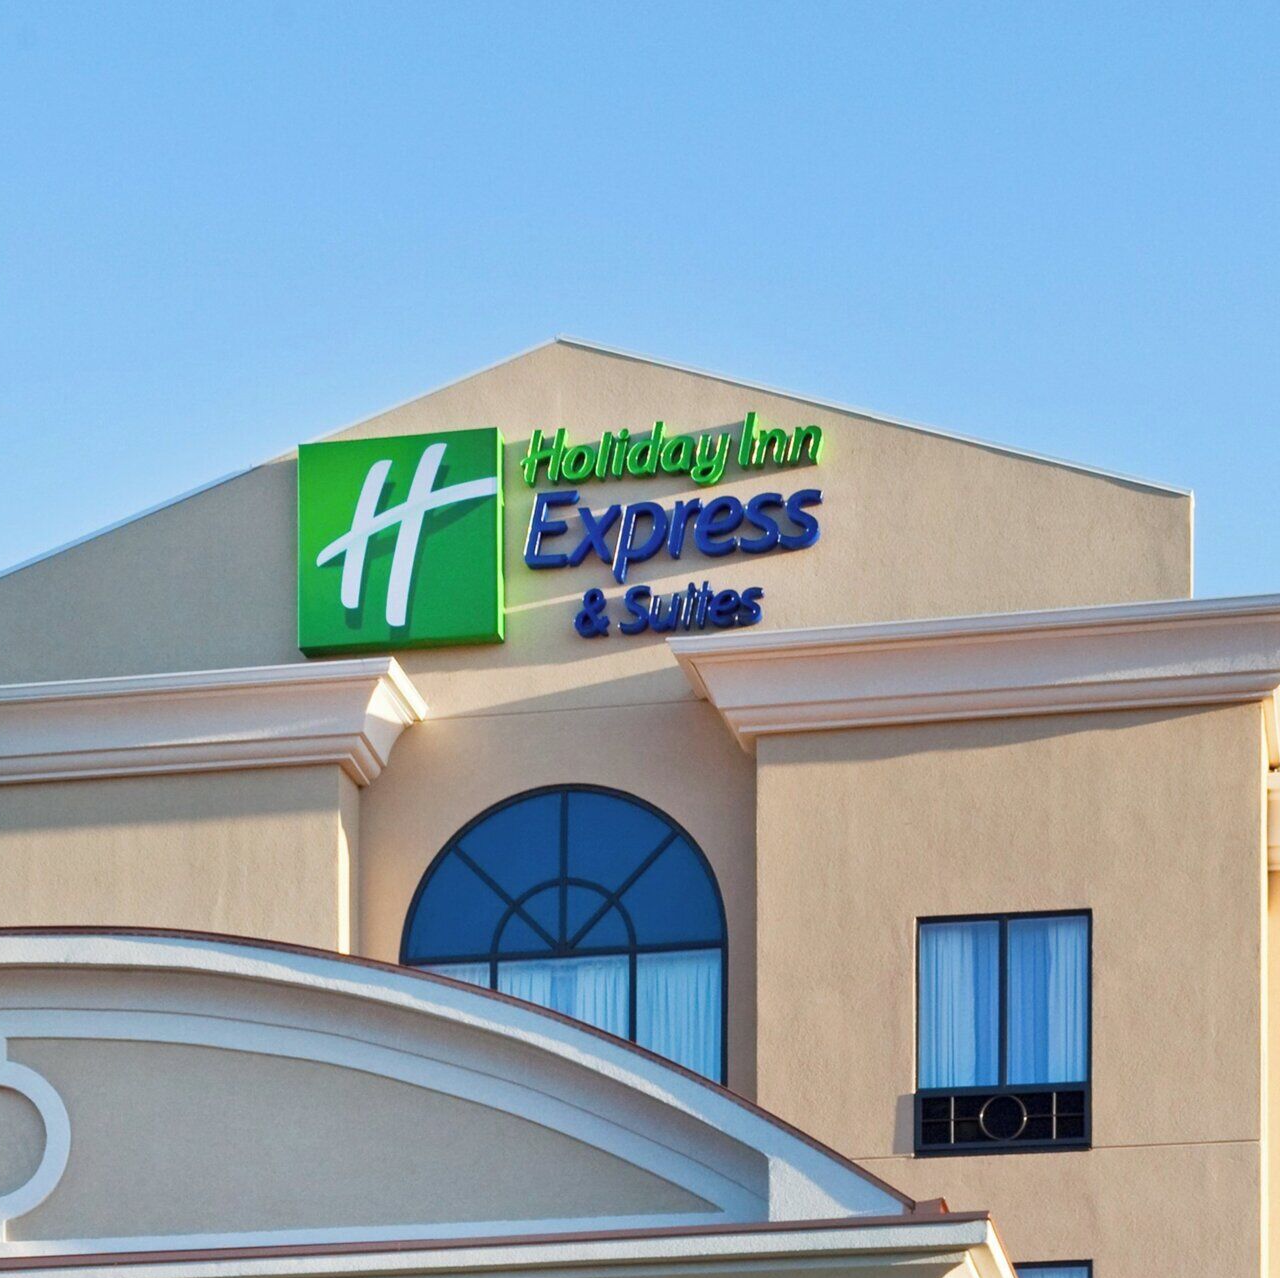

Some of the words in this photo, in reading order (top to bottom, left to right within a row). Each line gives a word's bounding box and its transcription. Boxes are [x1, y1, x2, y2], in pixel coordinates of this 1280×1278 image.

[520, 421, 731, 487] Holiday
[738, 411, 824, 470] Inn
[523, 489, 823, 585] Express
[574, 587, 610, 638] &
[618, 580, 765, 635] Suites
